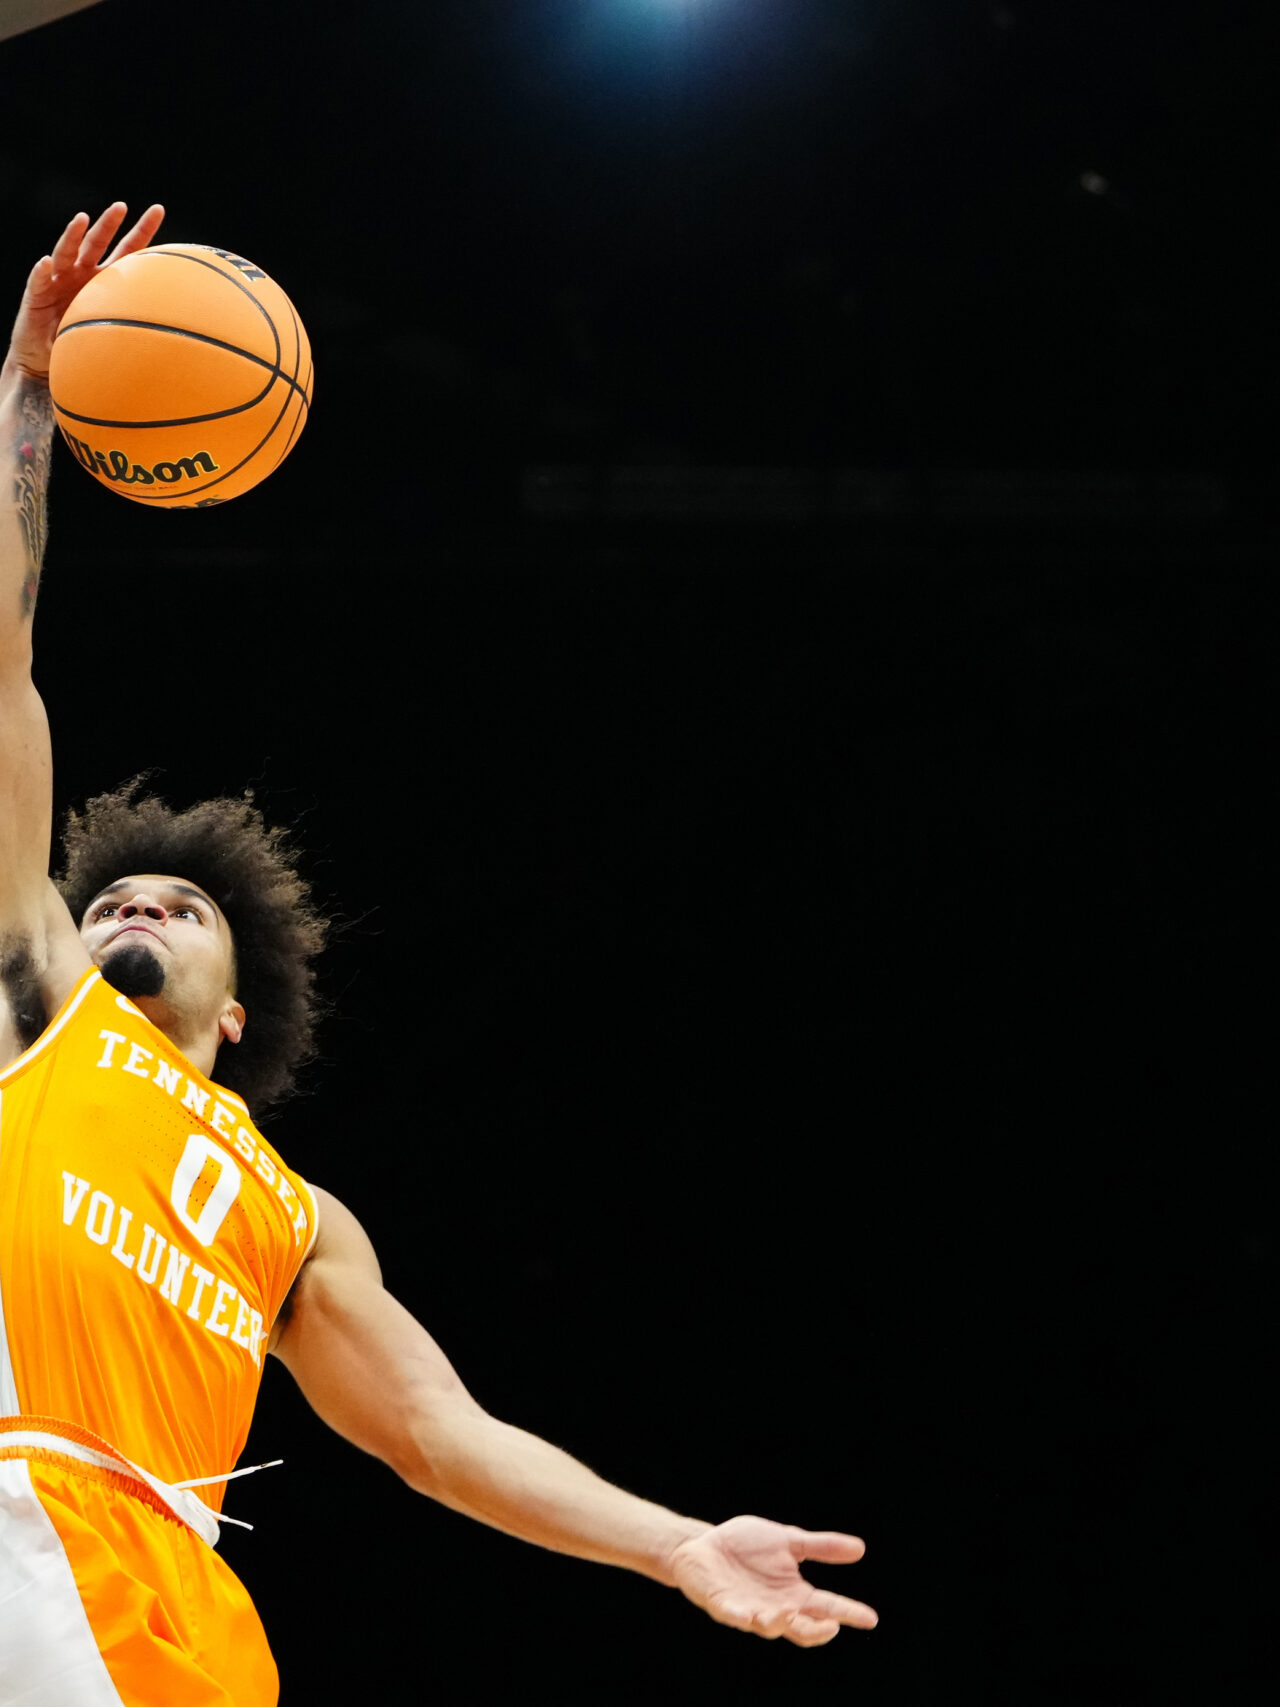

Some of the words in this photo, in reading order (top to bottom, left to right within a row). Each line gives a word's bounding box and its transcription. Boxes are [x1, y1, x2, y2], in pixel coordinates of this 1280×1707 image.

[63, 429, 219, 486] Wilson
[170, 1134, 242, 1247] 0
[61, 1170, 268, 1371] VOLUNTEER
